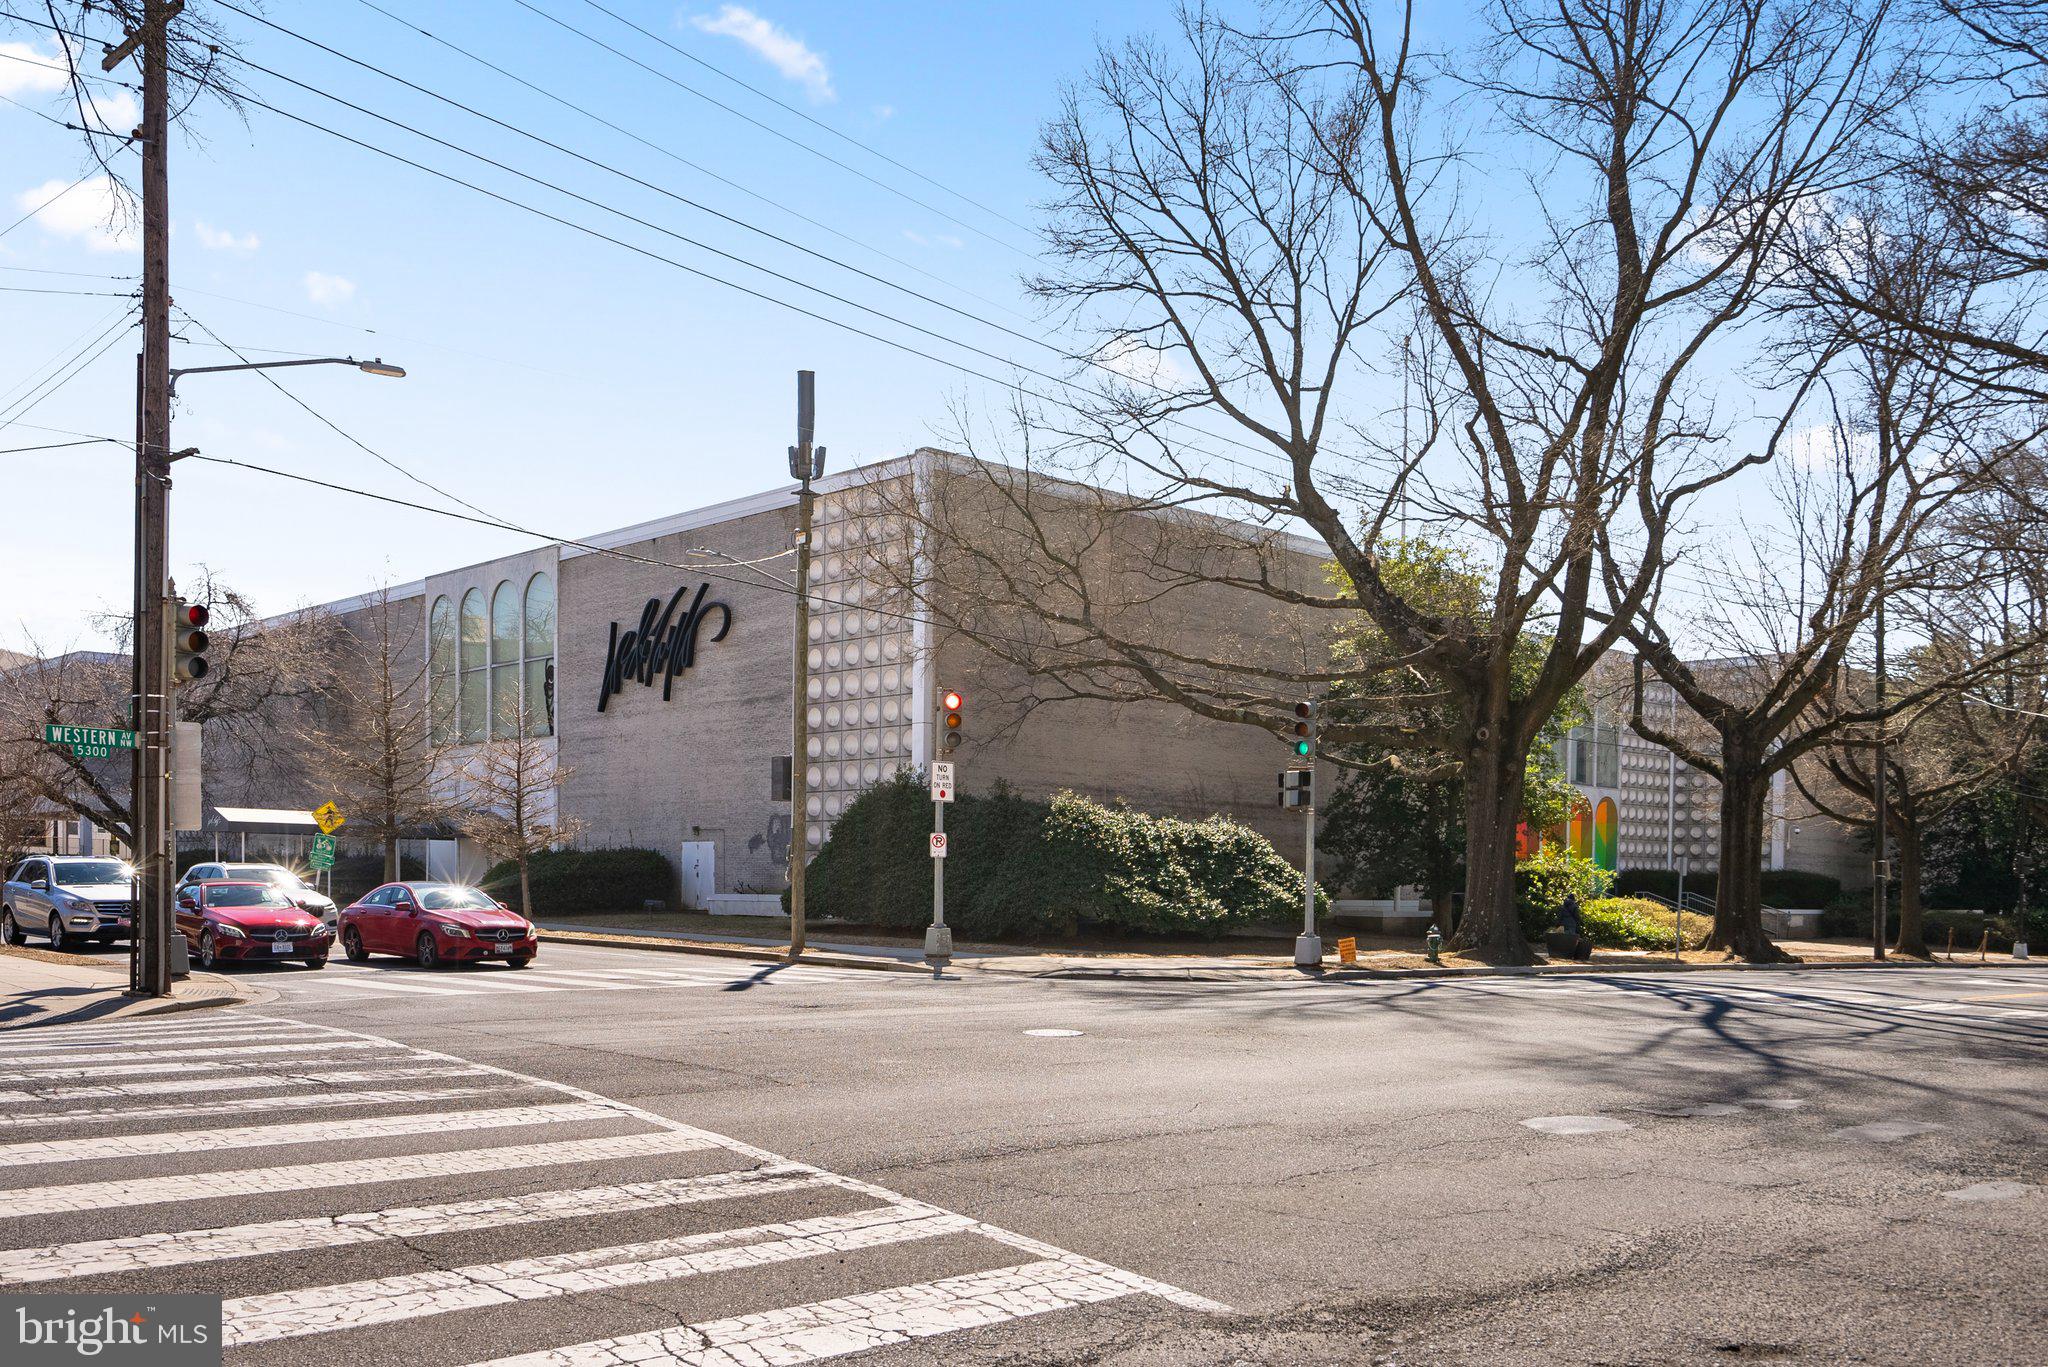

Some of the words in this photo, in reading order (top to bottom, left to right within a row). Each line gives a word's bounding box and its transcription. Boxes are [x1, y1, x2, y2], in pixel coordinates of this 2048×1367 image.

[52, 727, 116, 746] WESTERN
[121, 732, 132, 740] AV
[120, 739, 132, 747] NW
[77, 745, 107, 757] 5300
[938, 765, 948, 773] NO
